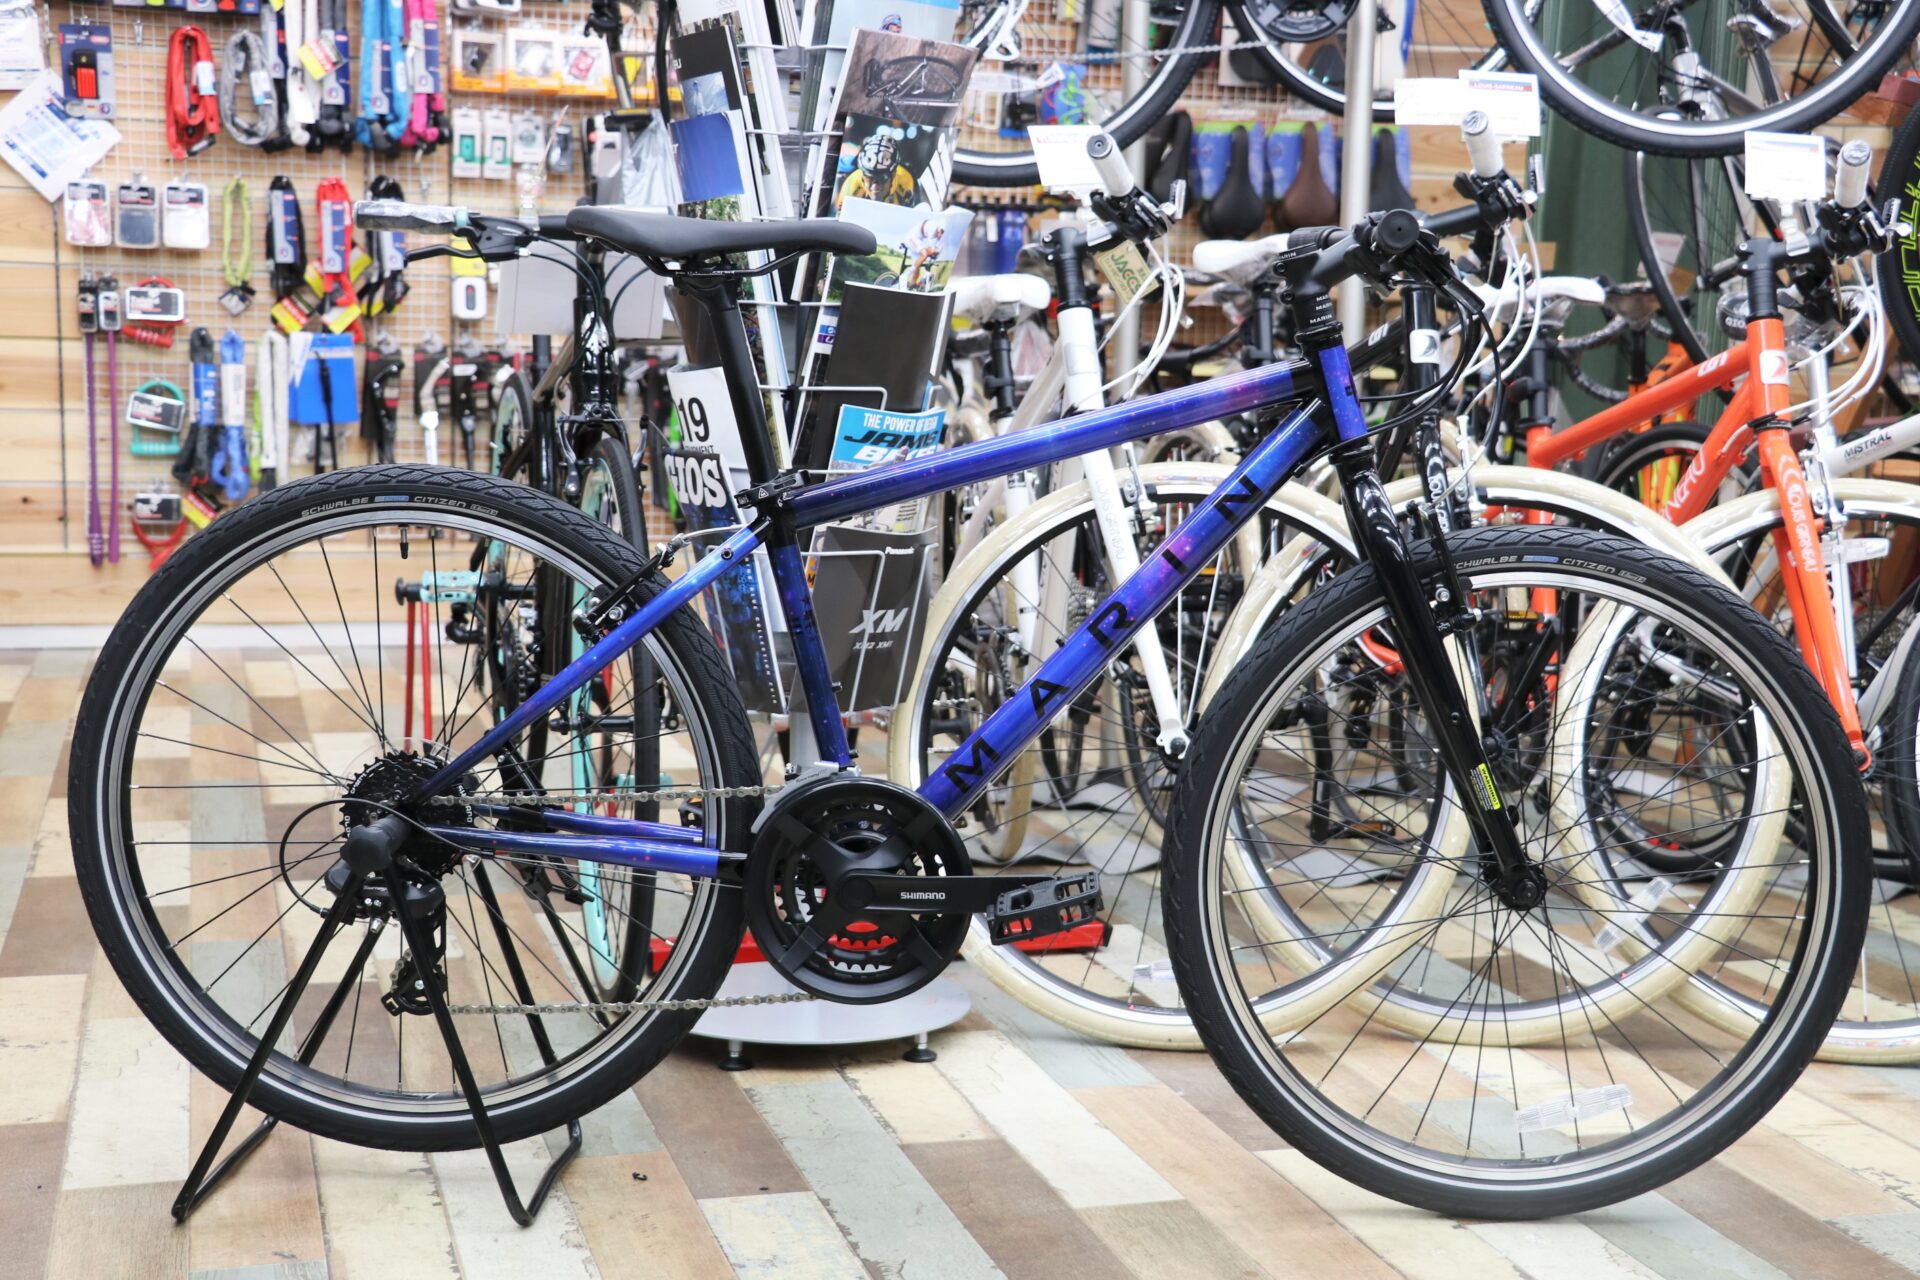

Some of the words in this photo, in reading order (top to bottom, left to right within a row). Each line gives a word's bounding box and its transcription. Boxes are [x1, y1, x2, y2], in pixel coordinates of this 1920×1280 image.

[1309, 314, 1333, 324] MARIN
[1725, 316, 1747, 329] GIO
[863, 412, 883, 429] THE
[883, 415, 914, 433] POWER
[843, 429, 939, 449] JAMIS
[1844, 431, 1892, 458] MISTRAL
[664, 454, 727, 508] GIOS
[301, 496, 369, 517] SCHWALBE
[414, 495, 467, 508] CITIZEN
[1454, 555, 1518, 570] CHWALBE
[1562, 557, 1616, 574] CITIZEN
[848, 607, 909, 634] XM
[944, 473, 1265, 793] MARIN
[900, 891, 946, 901] SHIMANO
